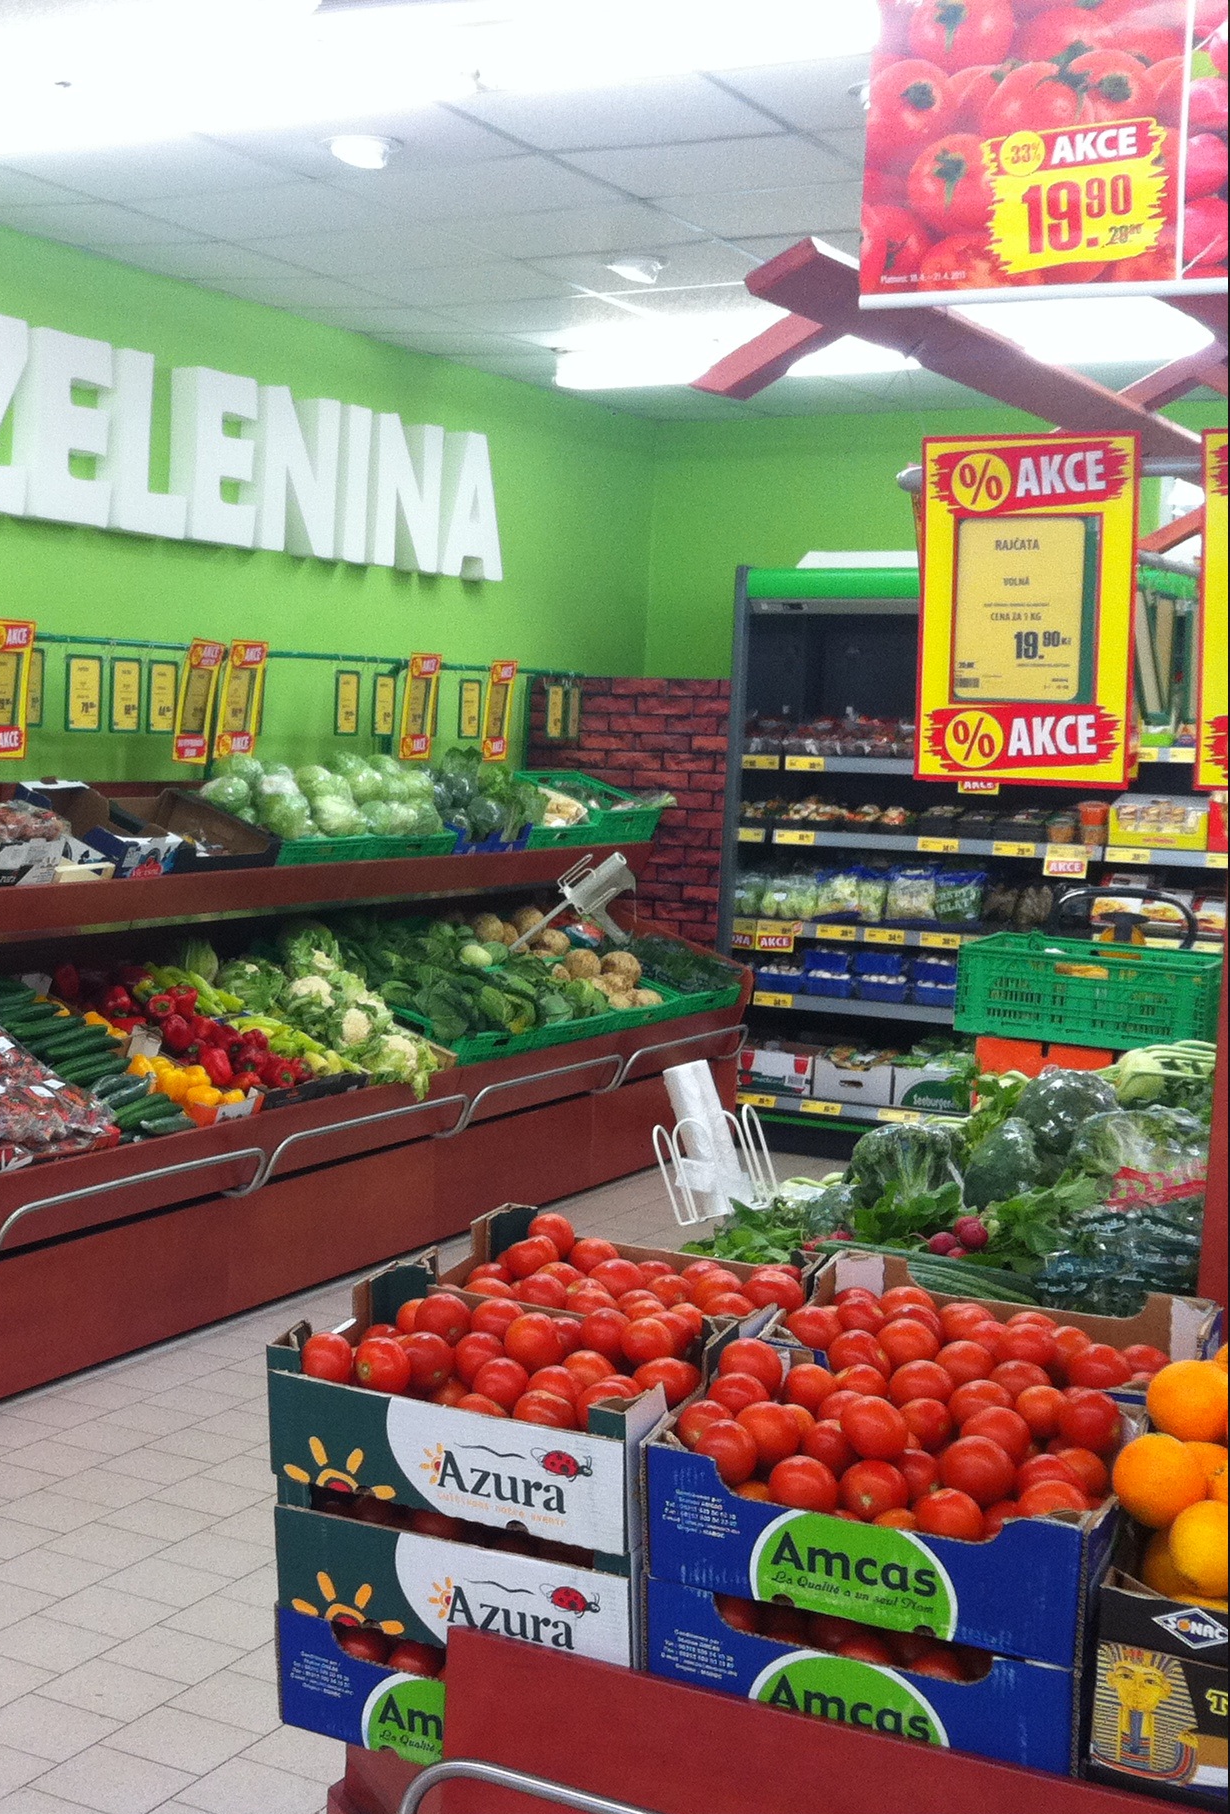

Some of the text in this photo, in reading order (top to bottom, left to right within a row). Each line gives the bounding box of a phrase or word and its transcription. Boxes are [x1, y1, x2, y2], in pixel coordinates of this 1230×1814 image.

[1051, 126, 1137, 165] AKCE
[1015, 450, 1108, 499] AKCE
[995, 537, 1040, 551] RAJČATA
[6, 628, 28, 645] AKCE
[1007, 714, 1098, 758] AKCE
[1049, 860, 1082, 873] AKCE
[760, 936, 790, 948] AKCE
[437, 1450, 567, 1515] Azura
[770, 1531, 938, 1598] Amcas
[797, 1575, 841, 1595] Qualité
[447, 1585, 575, 1650] Azura
[770, 1673, 931, 1742] Amcas
